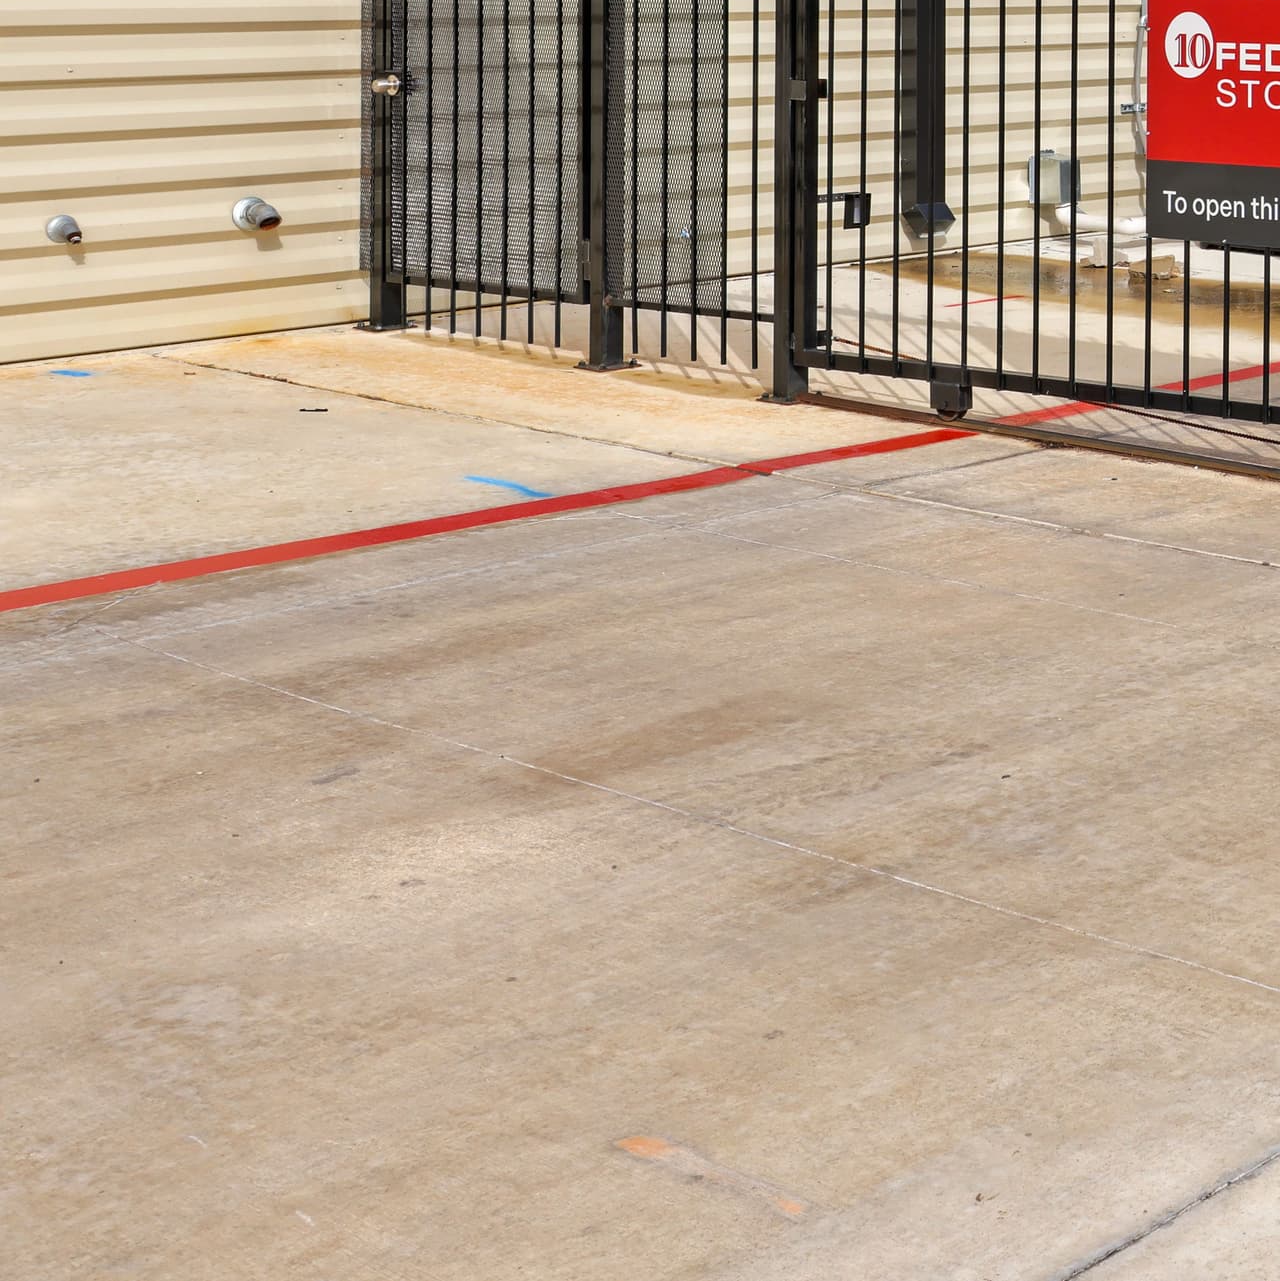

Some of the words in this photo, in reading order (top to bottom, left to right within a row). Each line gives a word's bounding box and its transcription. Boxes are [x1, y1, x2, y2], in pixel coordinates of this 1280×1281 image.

[1174, 33, 1211, 69] 10
[1162, 190, 1188, 215] To
[1192, 197, 1246, 223] open
